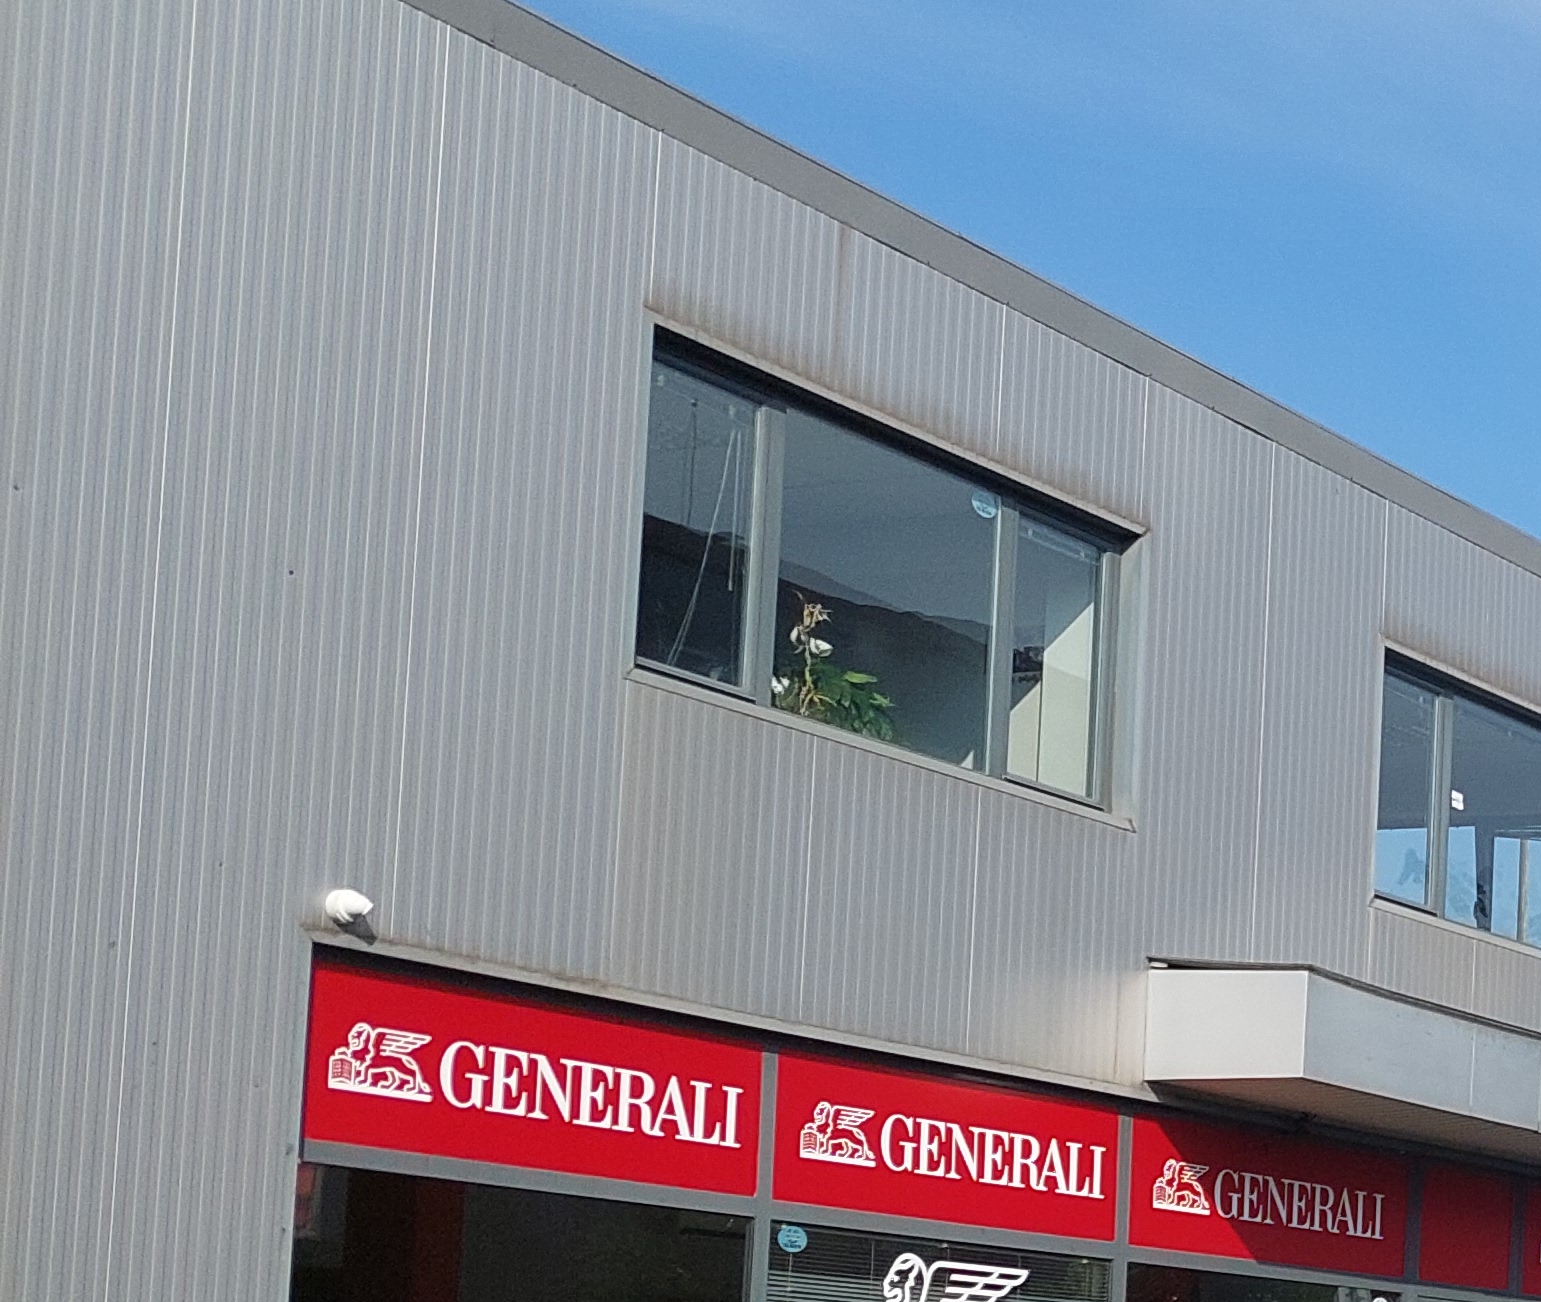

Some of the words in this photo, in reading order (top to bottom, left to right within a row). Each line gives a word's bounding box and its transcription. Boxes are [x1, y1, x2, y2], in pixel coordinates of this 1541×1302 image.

[439, 1040, 744, 1149] GENERALI
[880, 1113, 1107, 1200] GENERALI
[1213, 1168, 1384, 1240] GENERALI
